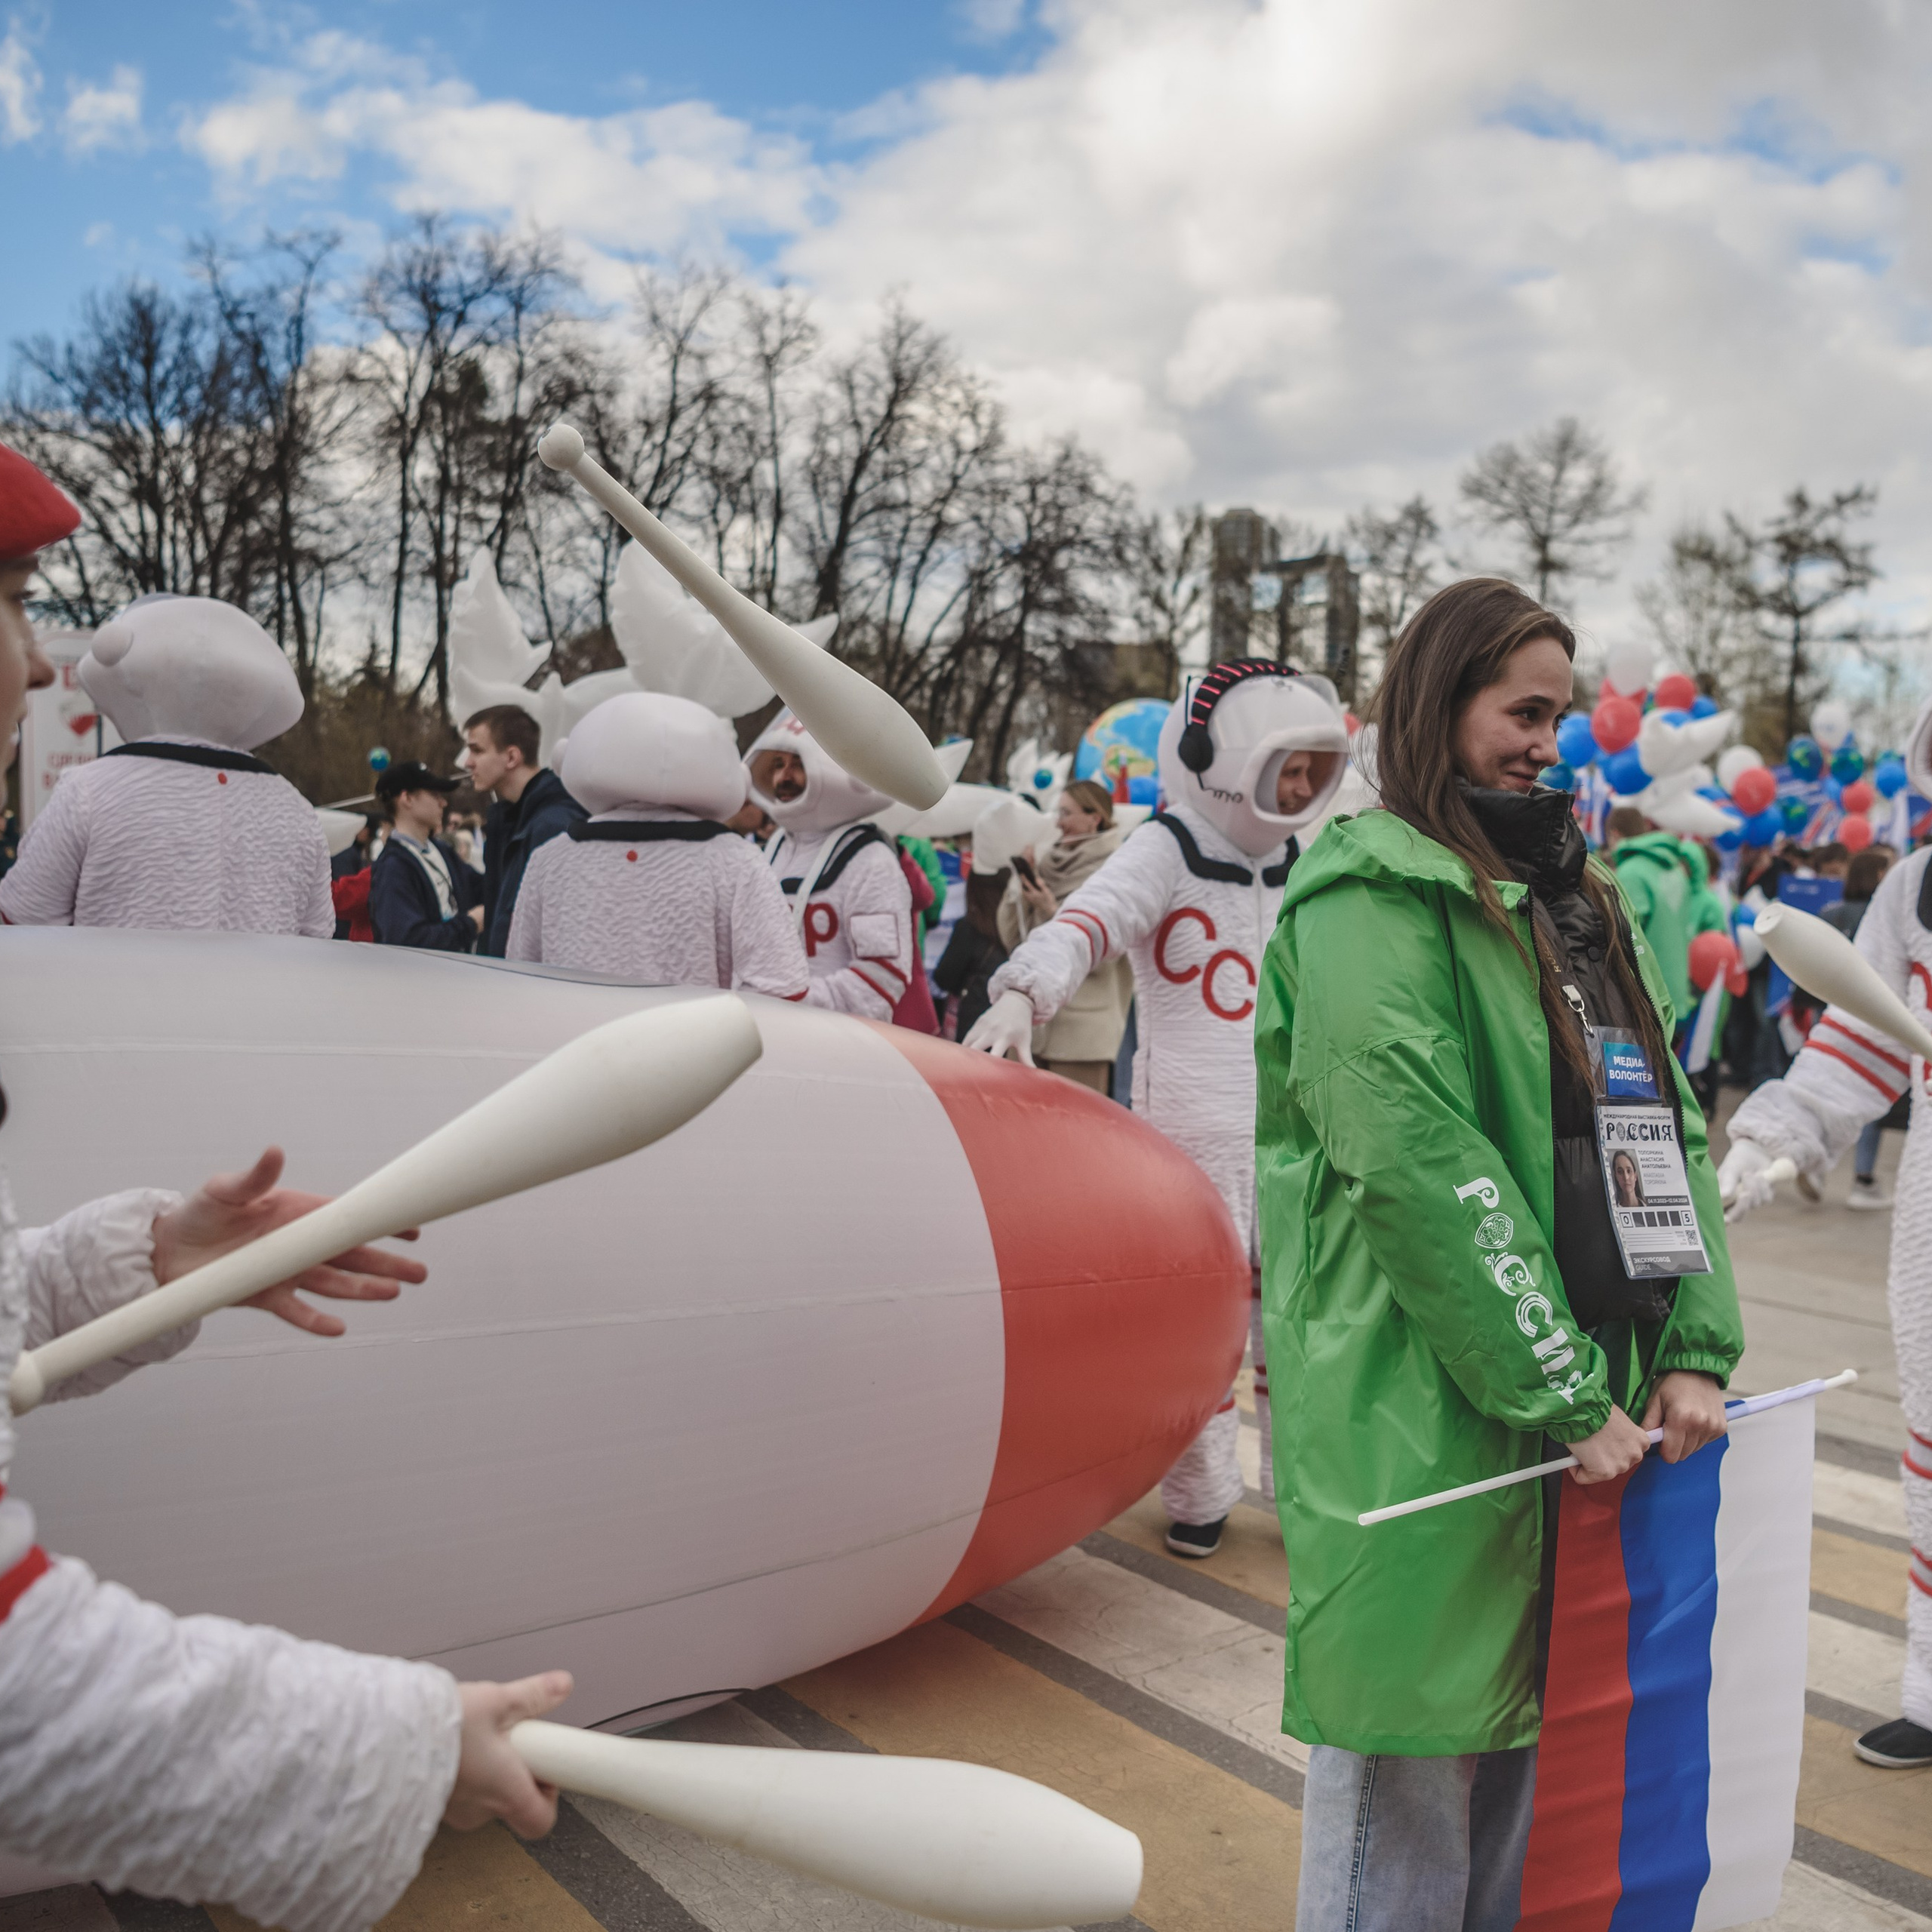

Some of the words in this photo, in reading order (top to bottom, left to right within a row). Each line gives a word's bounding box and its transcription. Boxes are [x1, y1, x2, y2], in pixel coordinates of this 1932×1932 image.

[1609, 1069, 1653, 1083] ВОЛОНТЁР
[1606, 1121, 1674, 1142] РОССИЯ
[1684, 1214, 1690, 1223] 5
[1633, 1256, 1671, 1264] ЭКСКУРСОВОД
